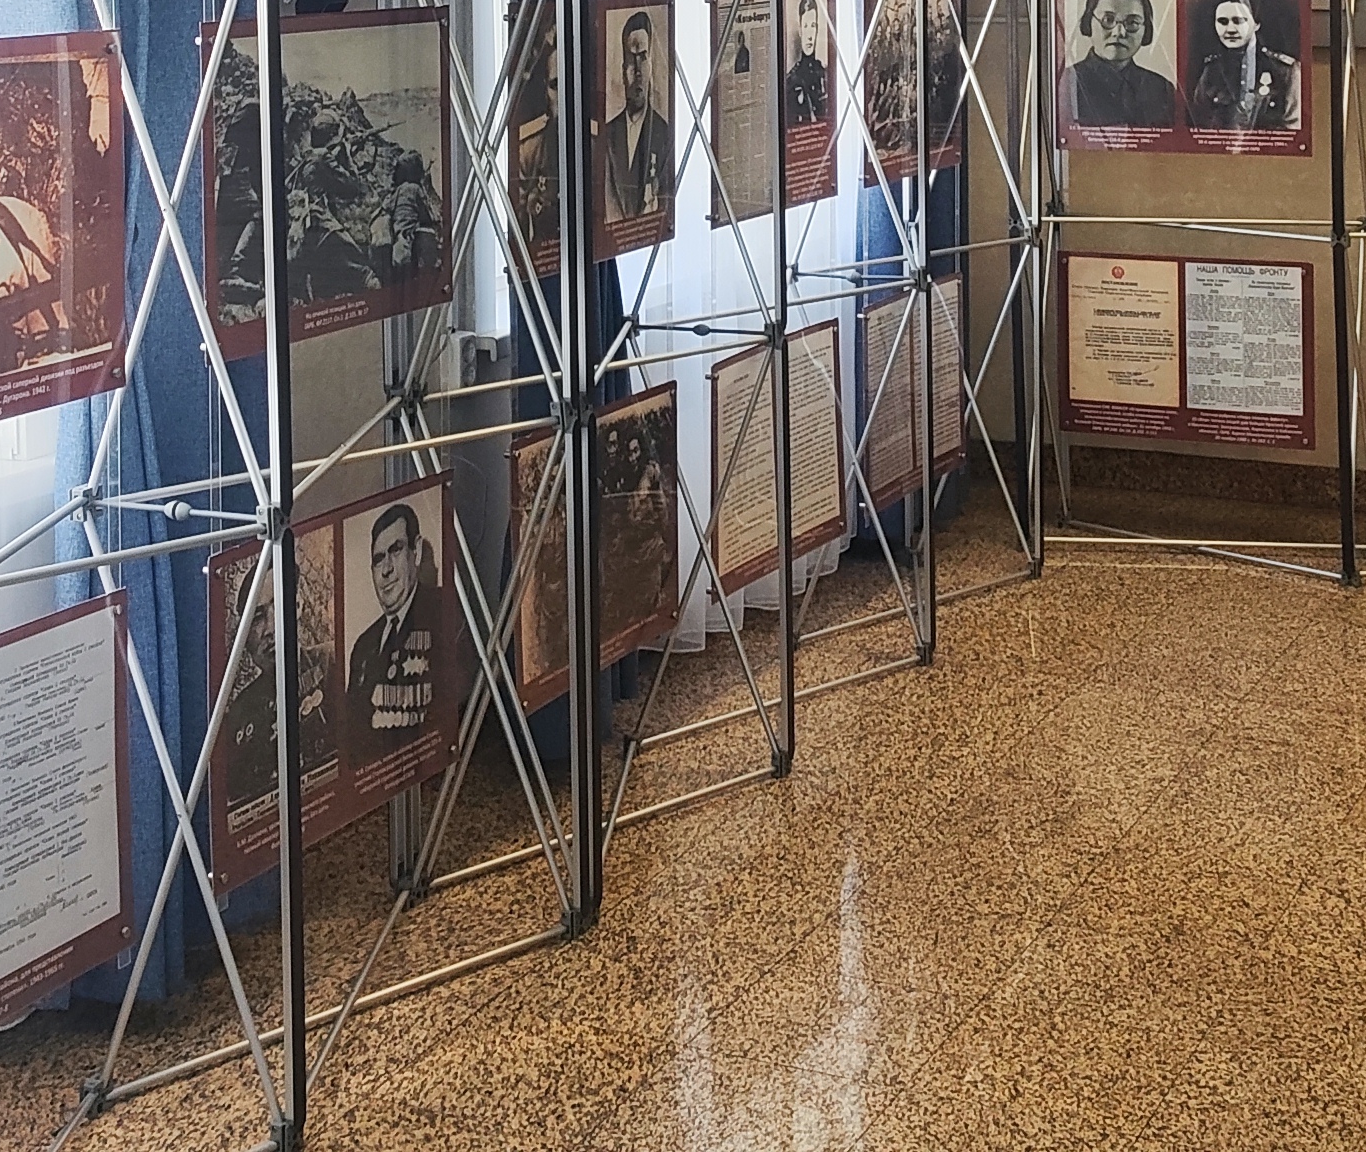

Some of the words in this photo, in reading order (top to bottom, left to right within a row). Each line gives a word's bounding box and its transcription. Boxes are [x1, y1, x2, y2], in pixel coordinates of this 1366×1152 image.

[1196, 265, 1219, 274] НАША
[1222, 266, 1256, 276] ПОМОЩЬ
[1259, 267, 1289, 277] ФРОНТУ
